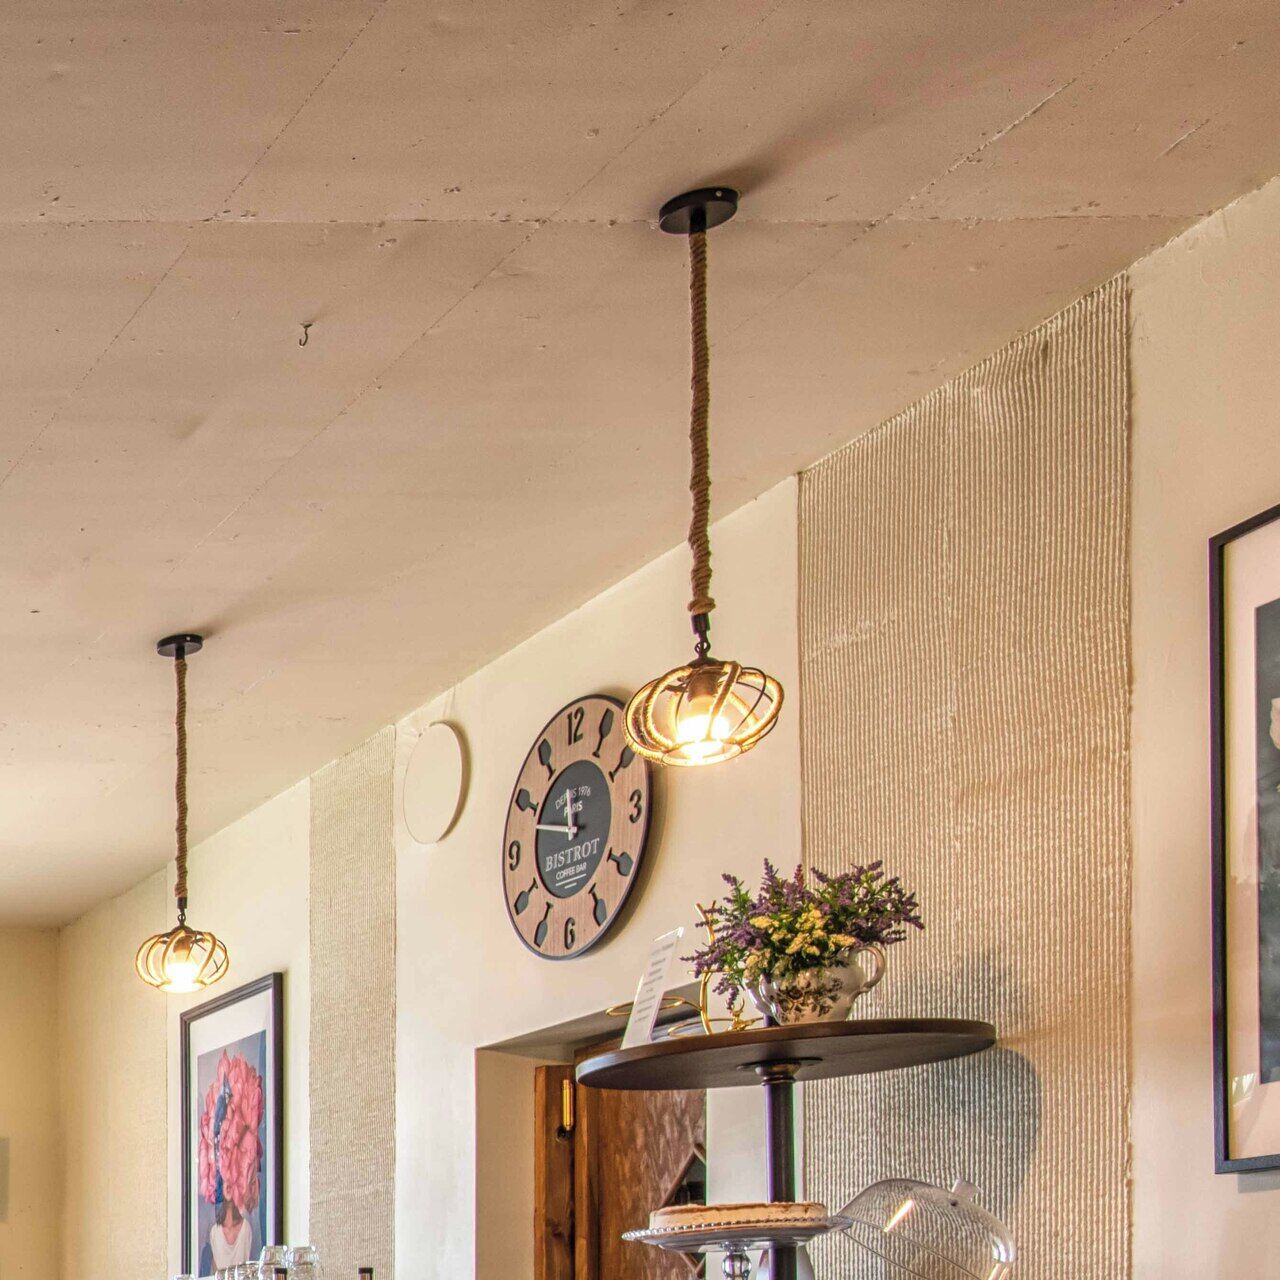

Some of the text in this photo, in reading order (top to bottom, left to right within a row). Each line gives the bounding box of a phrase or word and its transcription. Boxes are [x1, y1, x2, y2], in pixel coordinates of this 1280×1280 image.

[567, 707, 584, 746] 12
[555, 785, 591, 810] DEPIS 1976
[564, 800, 583, 818] PRIS
[629, 789, 642, 824] 3
[508, 840, 521, 872] 9
[545, 838, 600, 872] BISTROT
[556, 862, 587, 880] COFFEE BAR
[564, 917, 576, 950] 6
